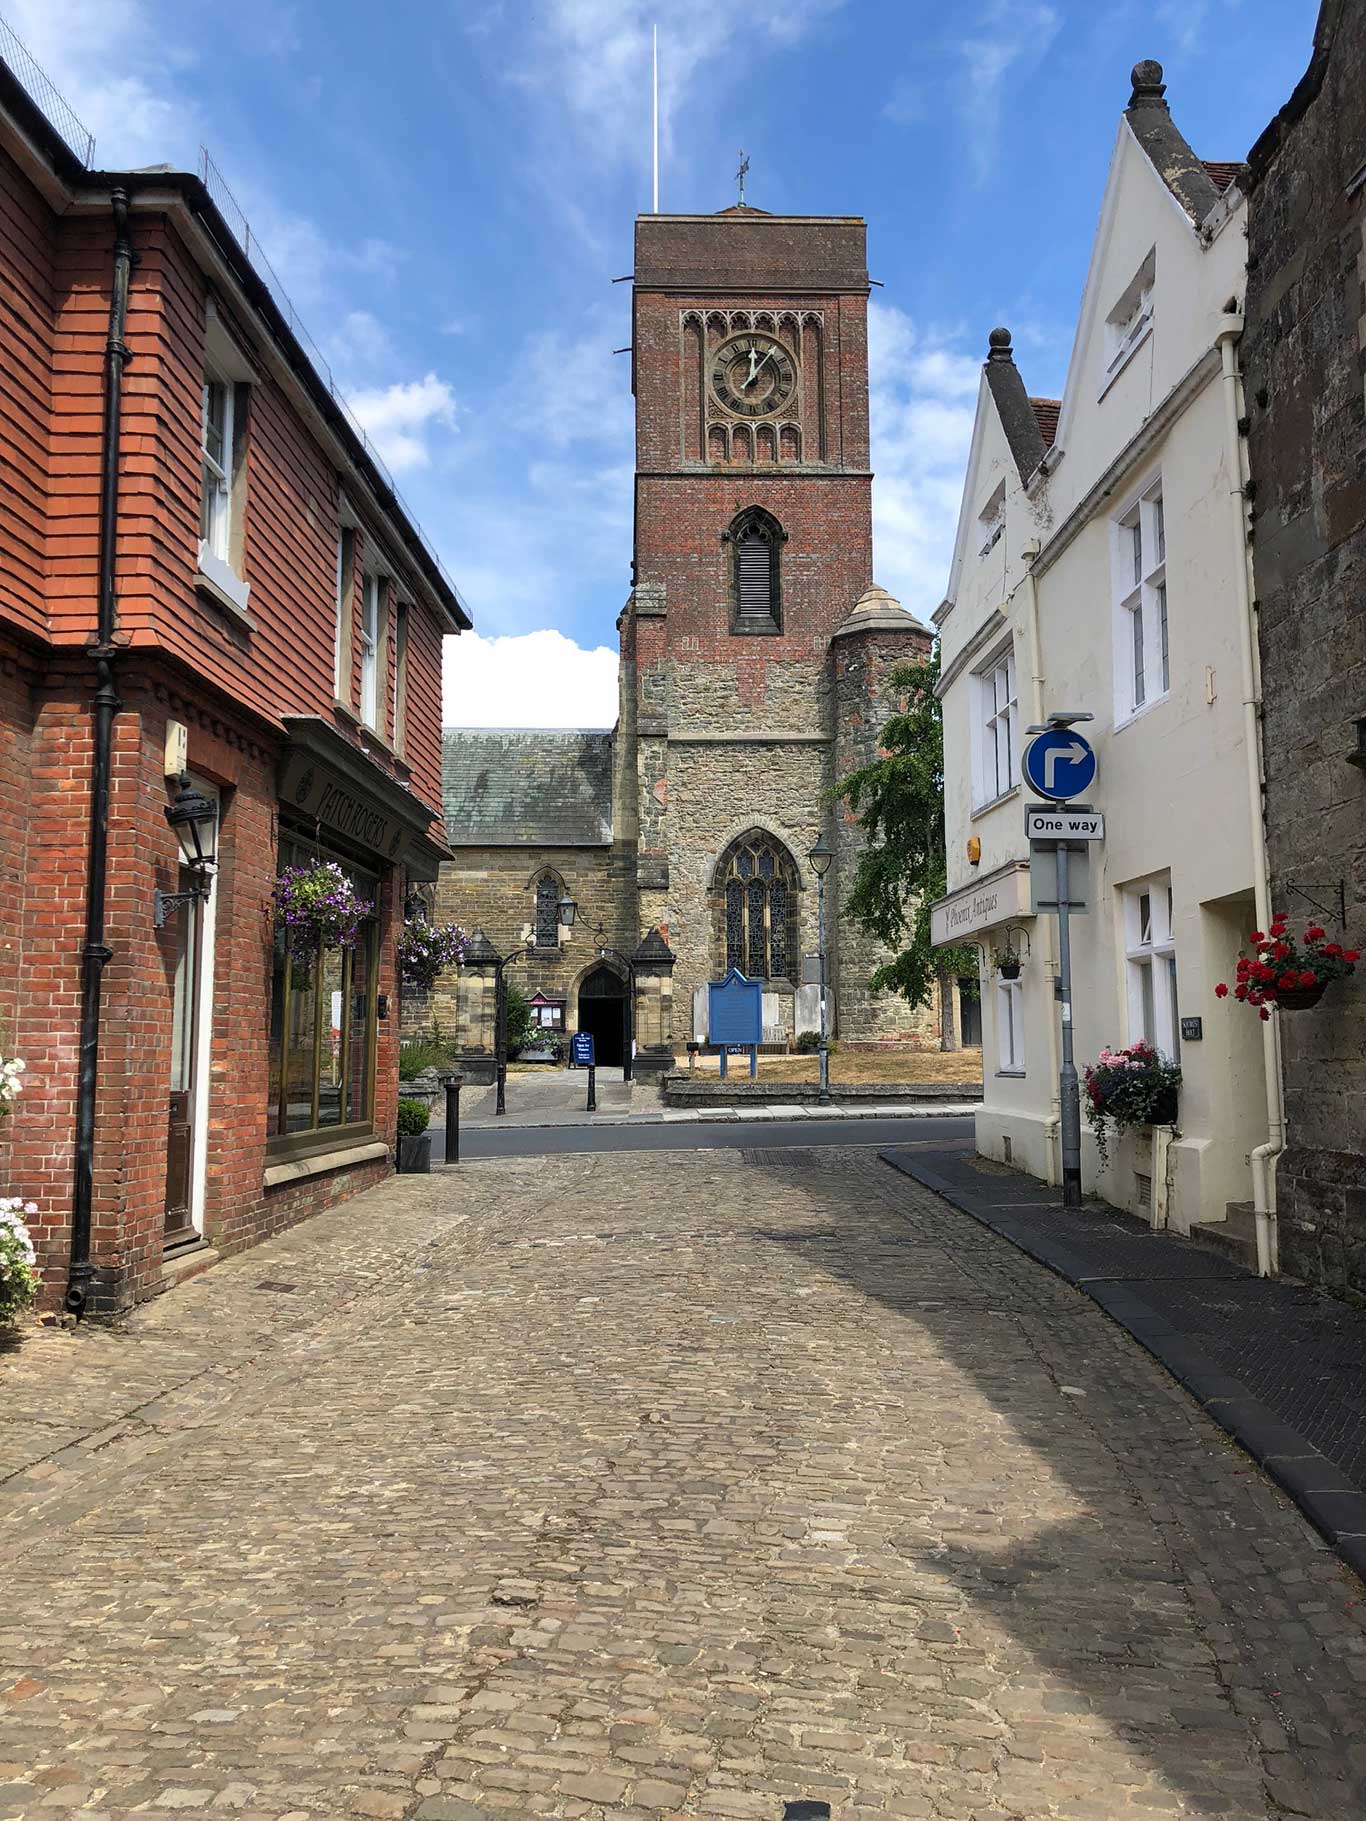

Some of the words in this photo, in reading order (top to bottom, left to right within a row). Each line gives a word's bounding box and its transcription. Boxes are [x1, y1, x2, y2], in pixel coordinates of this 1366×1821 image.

[317, 782, 356, 830] PATCH
[348, 803, 388, 848] ROGERS
[1034, 818, 1063, 830] One
[1068, 821, 1097, 833] way
[950, 904, 973, 927] Phoenix
[972, 893, 998, 920] Antiques
